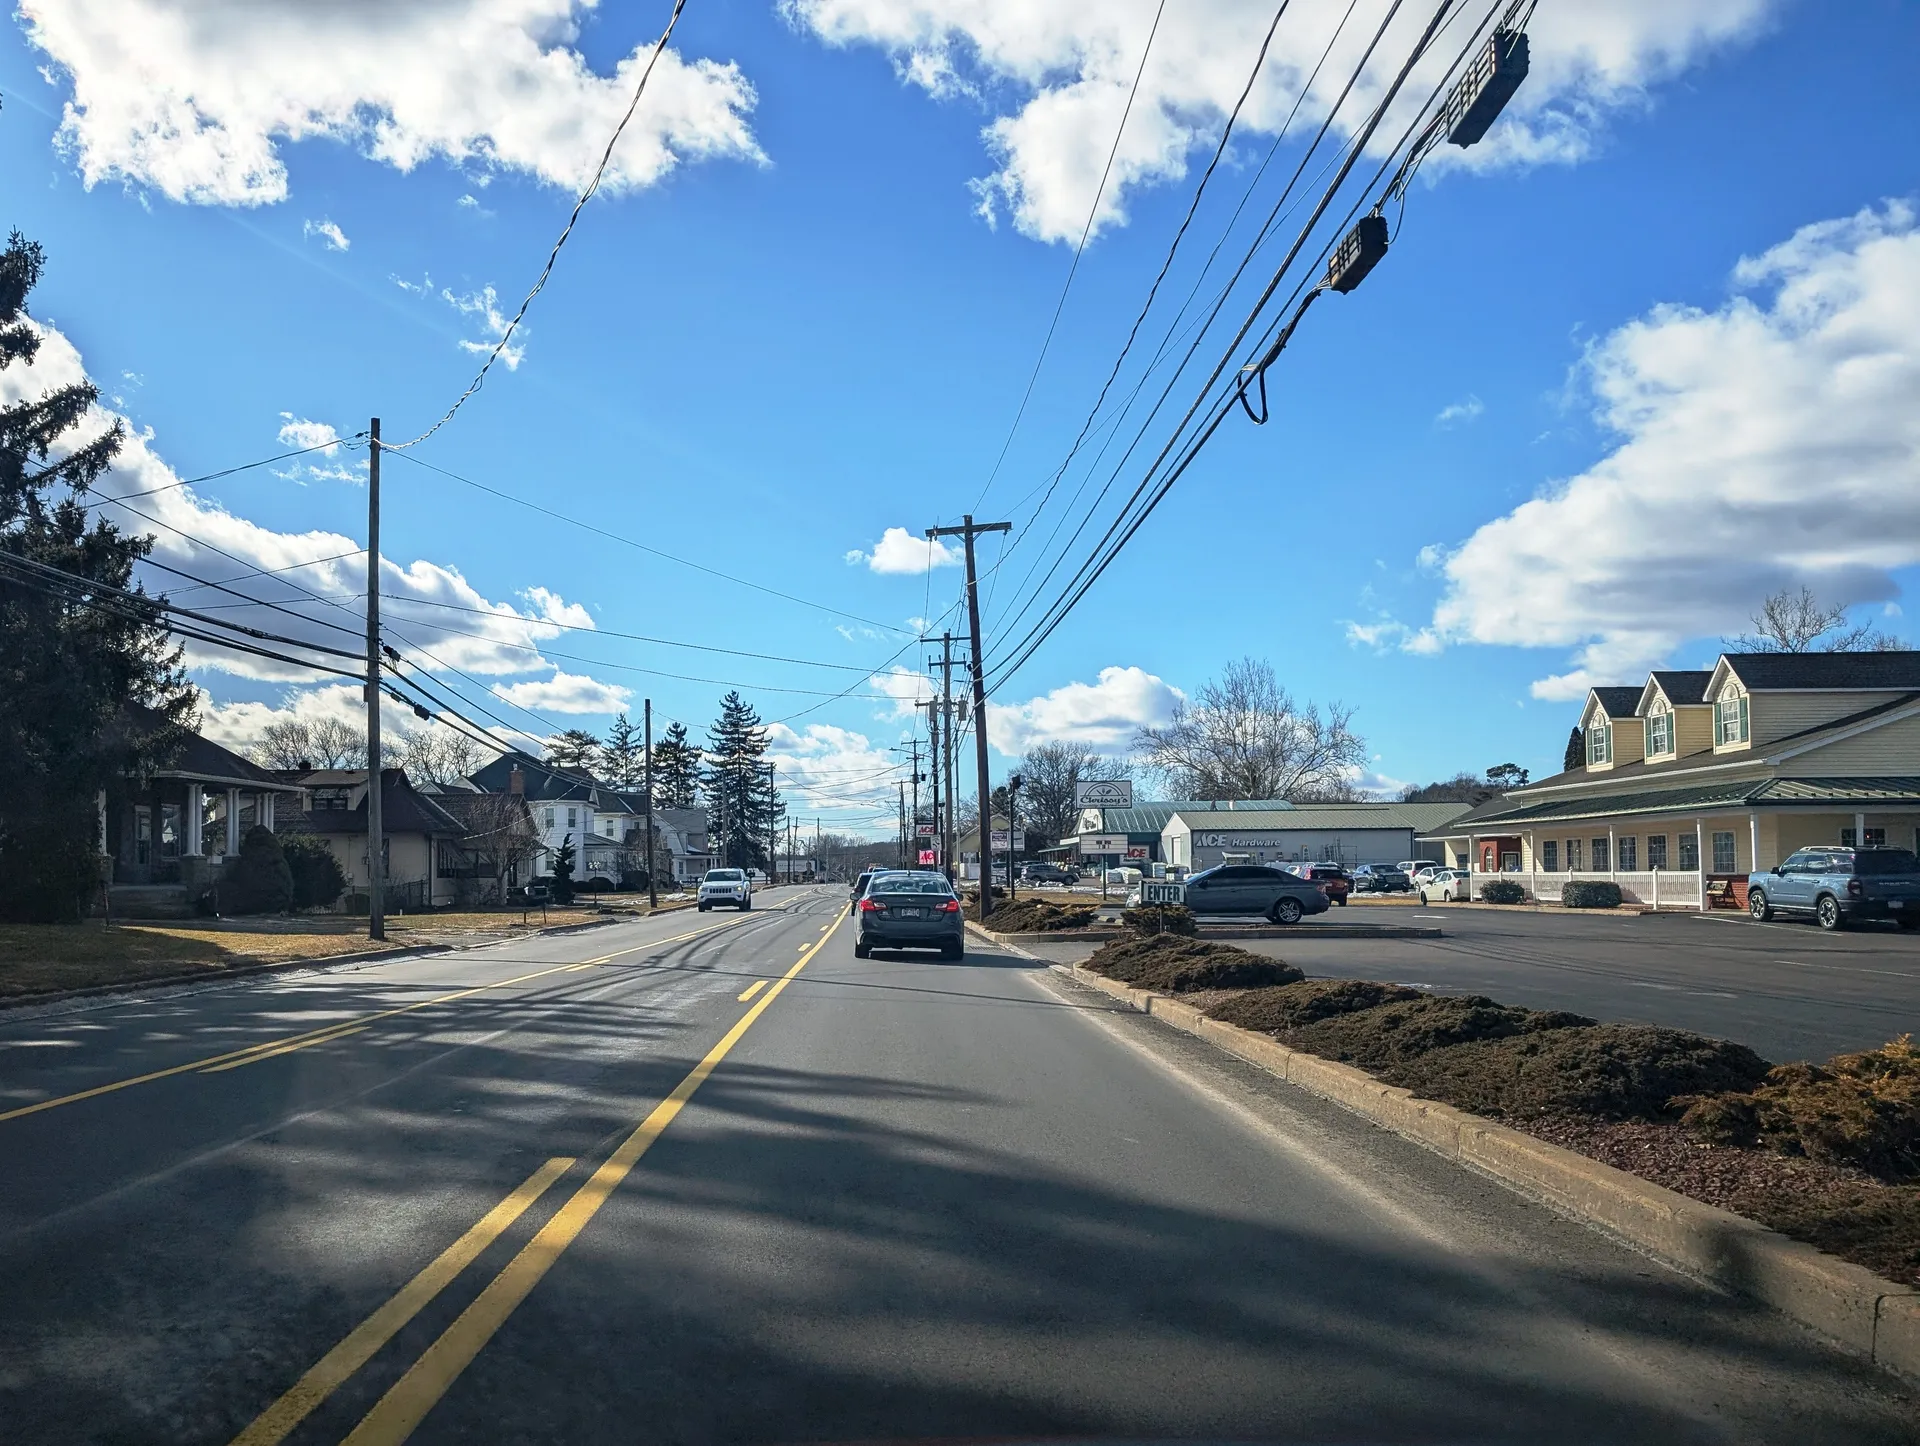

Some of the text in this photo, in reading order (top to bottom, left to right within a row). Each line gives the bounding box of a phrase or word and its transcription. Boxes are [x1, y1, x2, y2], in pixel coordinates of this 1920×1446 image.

[1197, 833, 1281, 847] ACE Hardware
[1148, 885, 1181, 901] ENTER
